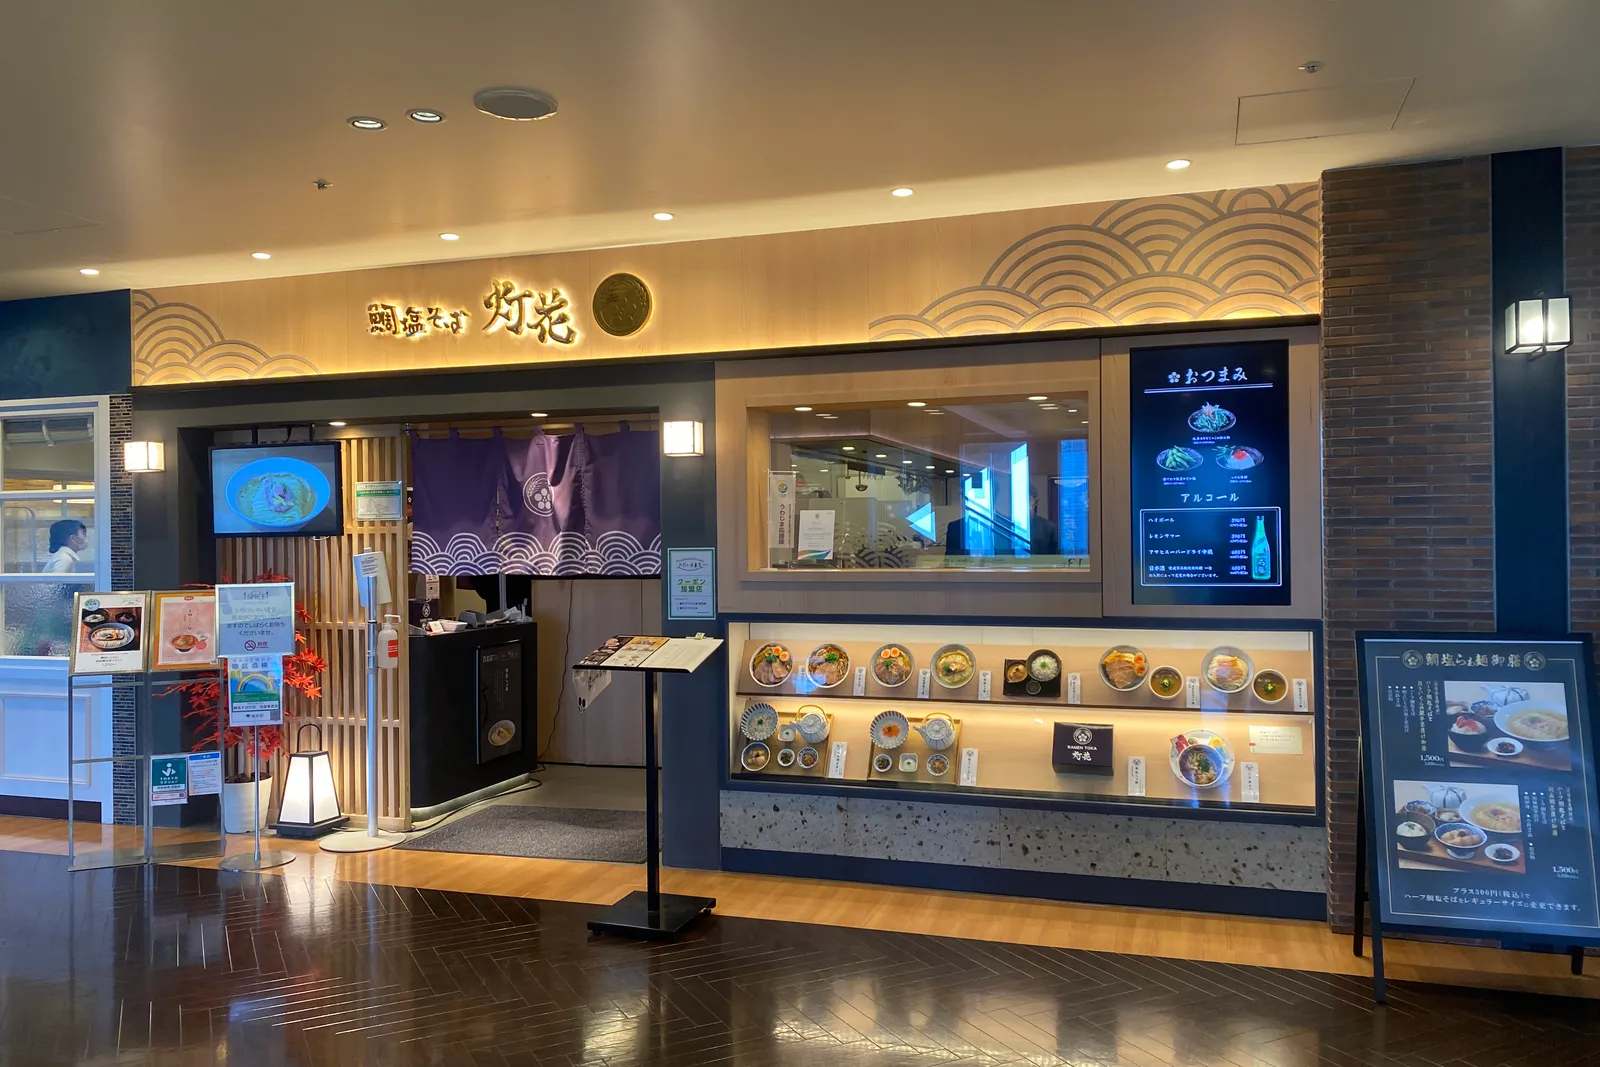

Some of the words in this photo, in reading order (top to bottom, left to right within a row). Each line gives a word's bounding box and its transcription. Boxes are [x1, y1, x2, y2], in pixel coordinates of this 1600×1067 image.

[366, 303, 469, 336] 鯛塩そば
[481, 279, 578, 345] 灯花
[1185, 366, 1248, 385] おつまみ
[1180, 492, 1240, 503] アルコール
[677, 578, 706, 586] クーポン
[680, 585, 703, 593] 加盟店
[1425, 651, 1521, 668] 鯛塩らぁ麺御膳
[1072, 751, 1092, 761] 灯花
